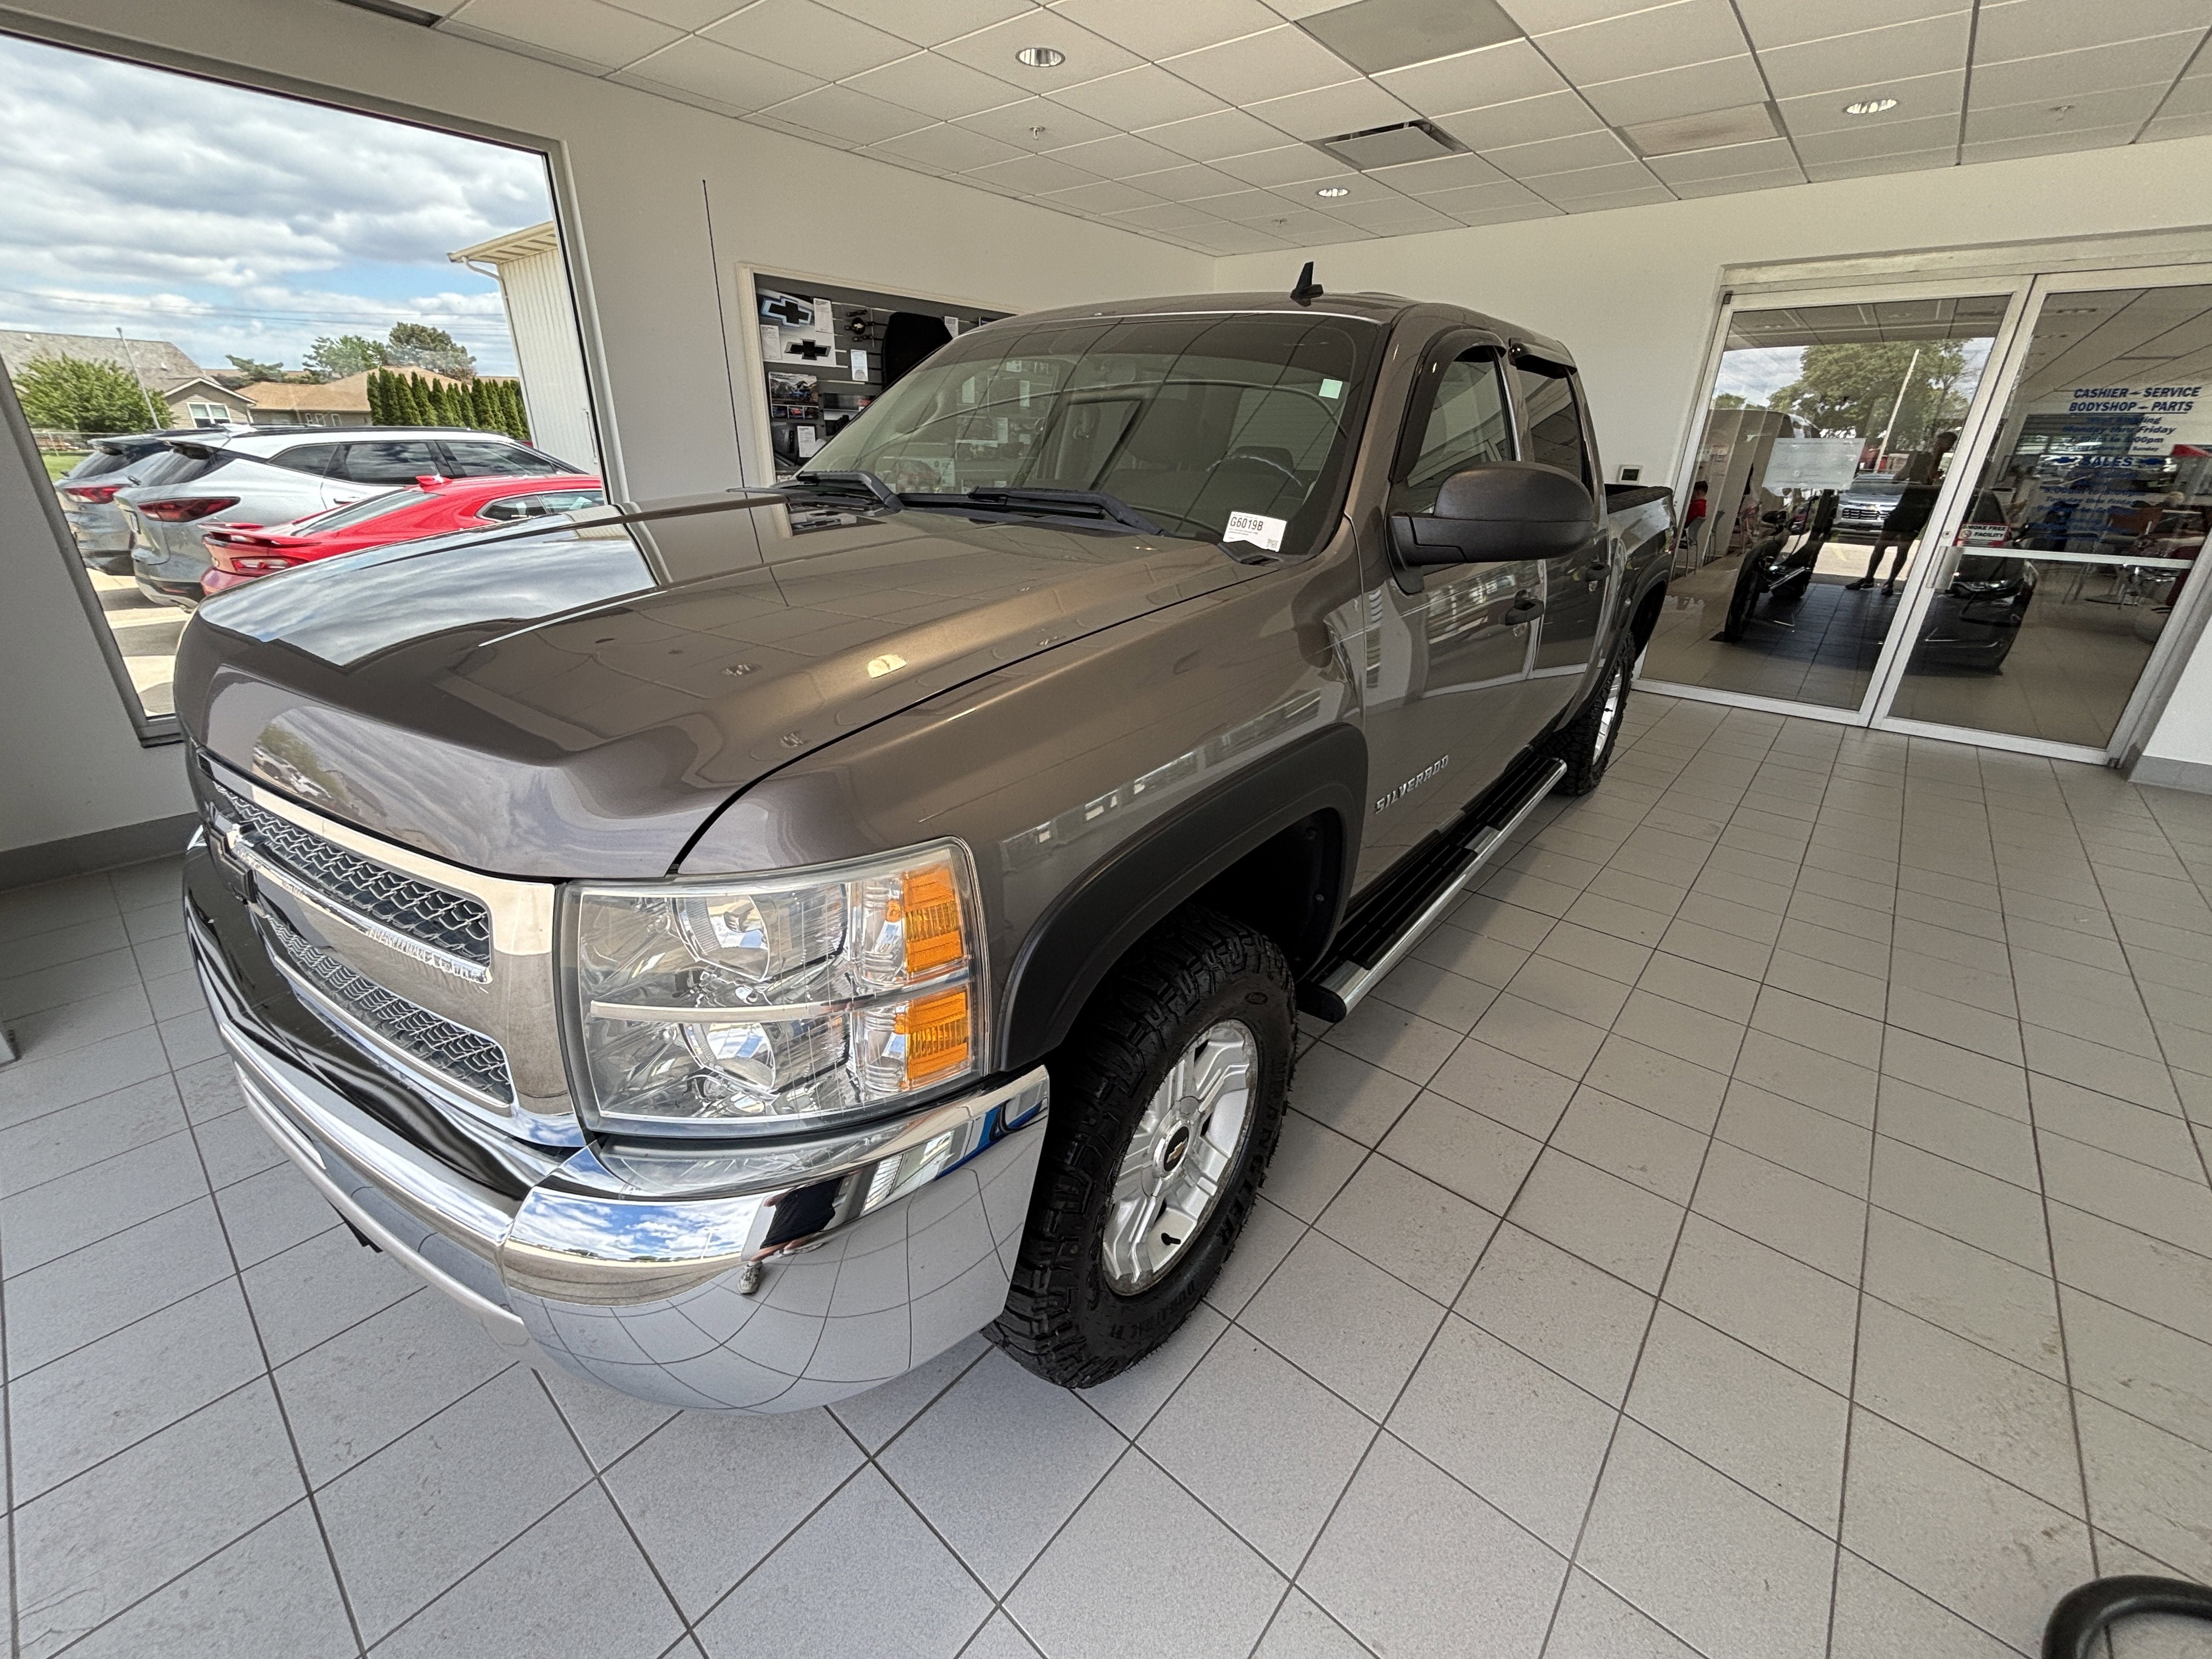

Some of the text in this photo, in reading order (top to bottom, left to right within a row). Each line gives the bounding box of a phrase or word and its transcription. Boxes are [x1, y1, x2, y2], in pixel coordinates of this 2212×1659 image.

[2074, 388, 2129, 398] CASHIER
[2143, 387, 2202, 397] SERVICE
[2069, 402, 2137, 411] BODYSHOP
[2152, 401, 2194, 411] PARTS
[2139, 426, 2177, 435] Friday
[2081, 456, 2134, 466] SALES
[1230, 517, 1263, 531] G6019B
[1374, 755, 1449, 814] SILVERADO
